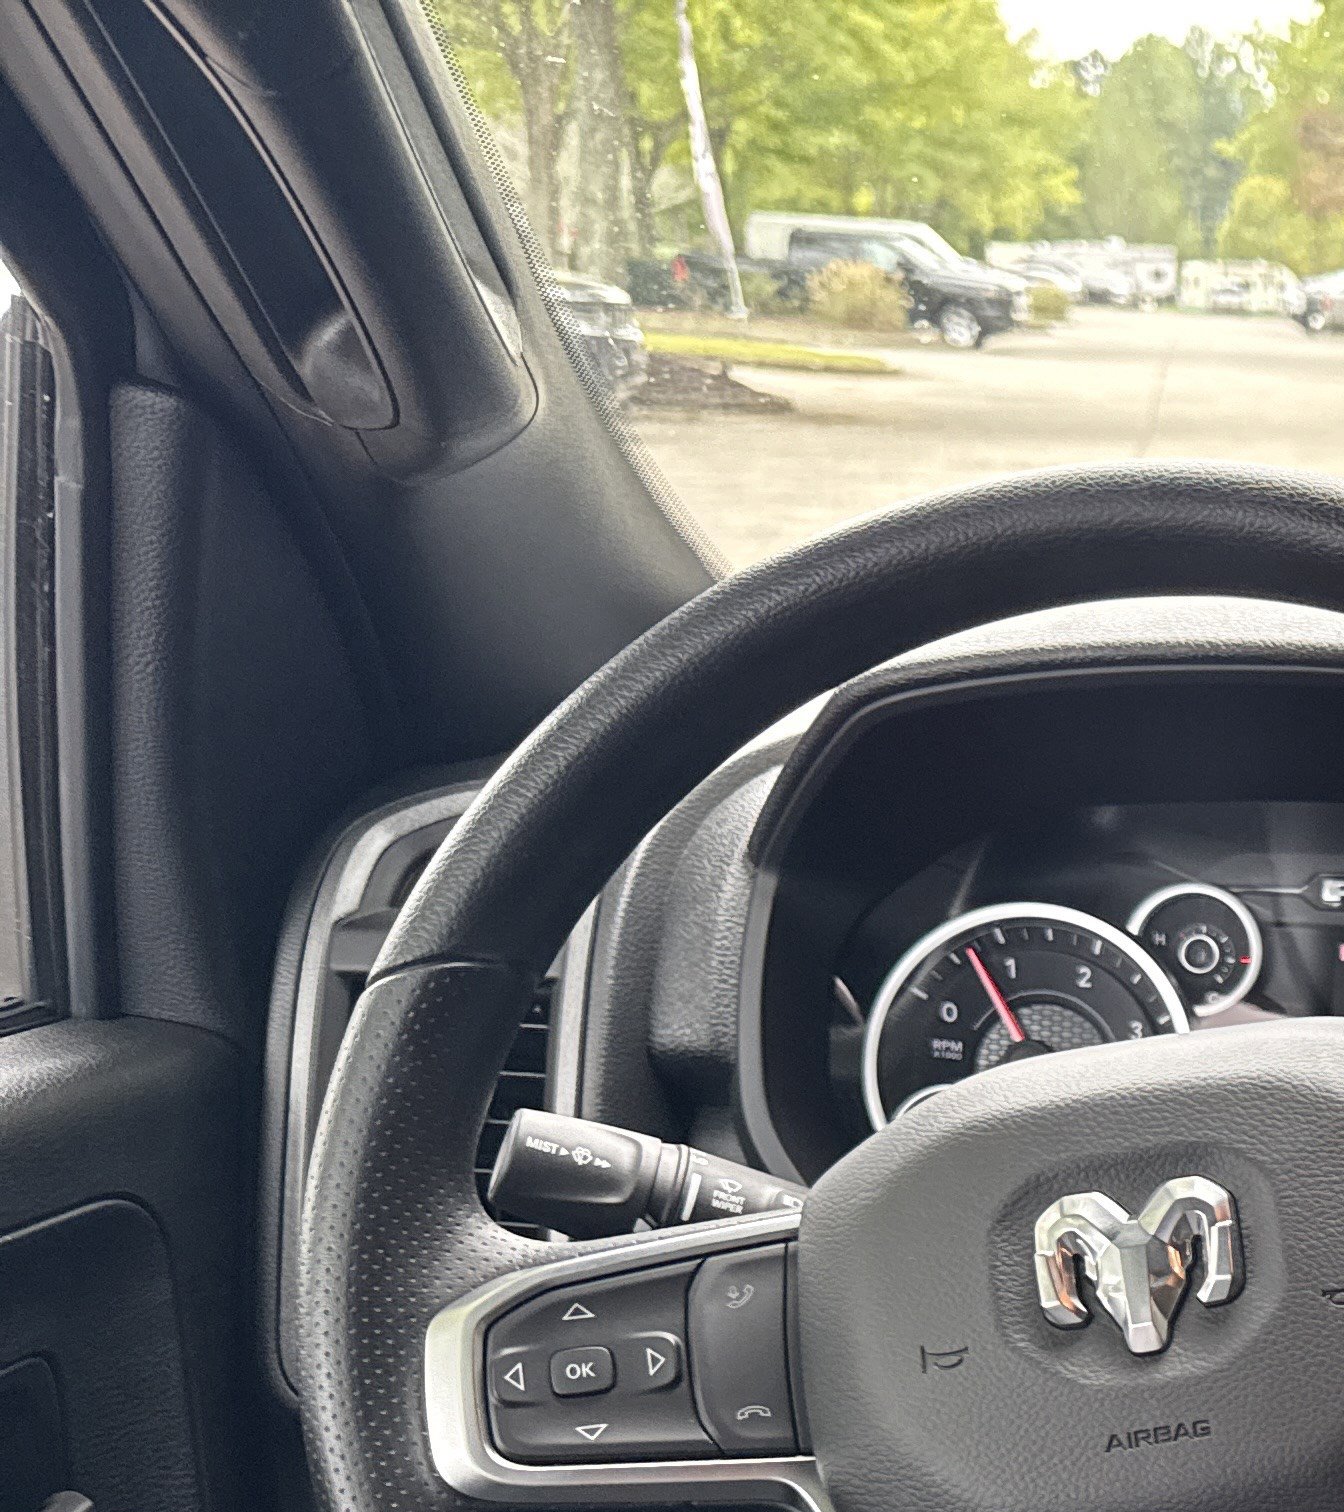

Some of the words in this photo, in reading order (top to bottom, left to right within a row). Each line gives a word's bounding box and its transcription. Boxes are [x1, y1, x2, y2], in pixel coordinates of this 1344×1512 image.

[1004, 957, 1018, 979] 1
[1075, 966, 1094, 988] 2
[939, 1002, 958, 1022] 0
[931, 1037, 964, 1053] RPM
[525, 1136, 560, 1156] MIST
[711, 1199, 744, 1215] WIPER
[713, 1189, 746, 1205] FRONT
[565, 1361, 597, 1380] OK
[1104, 1418, 1213, 1453] AIRBAG
